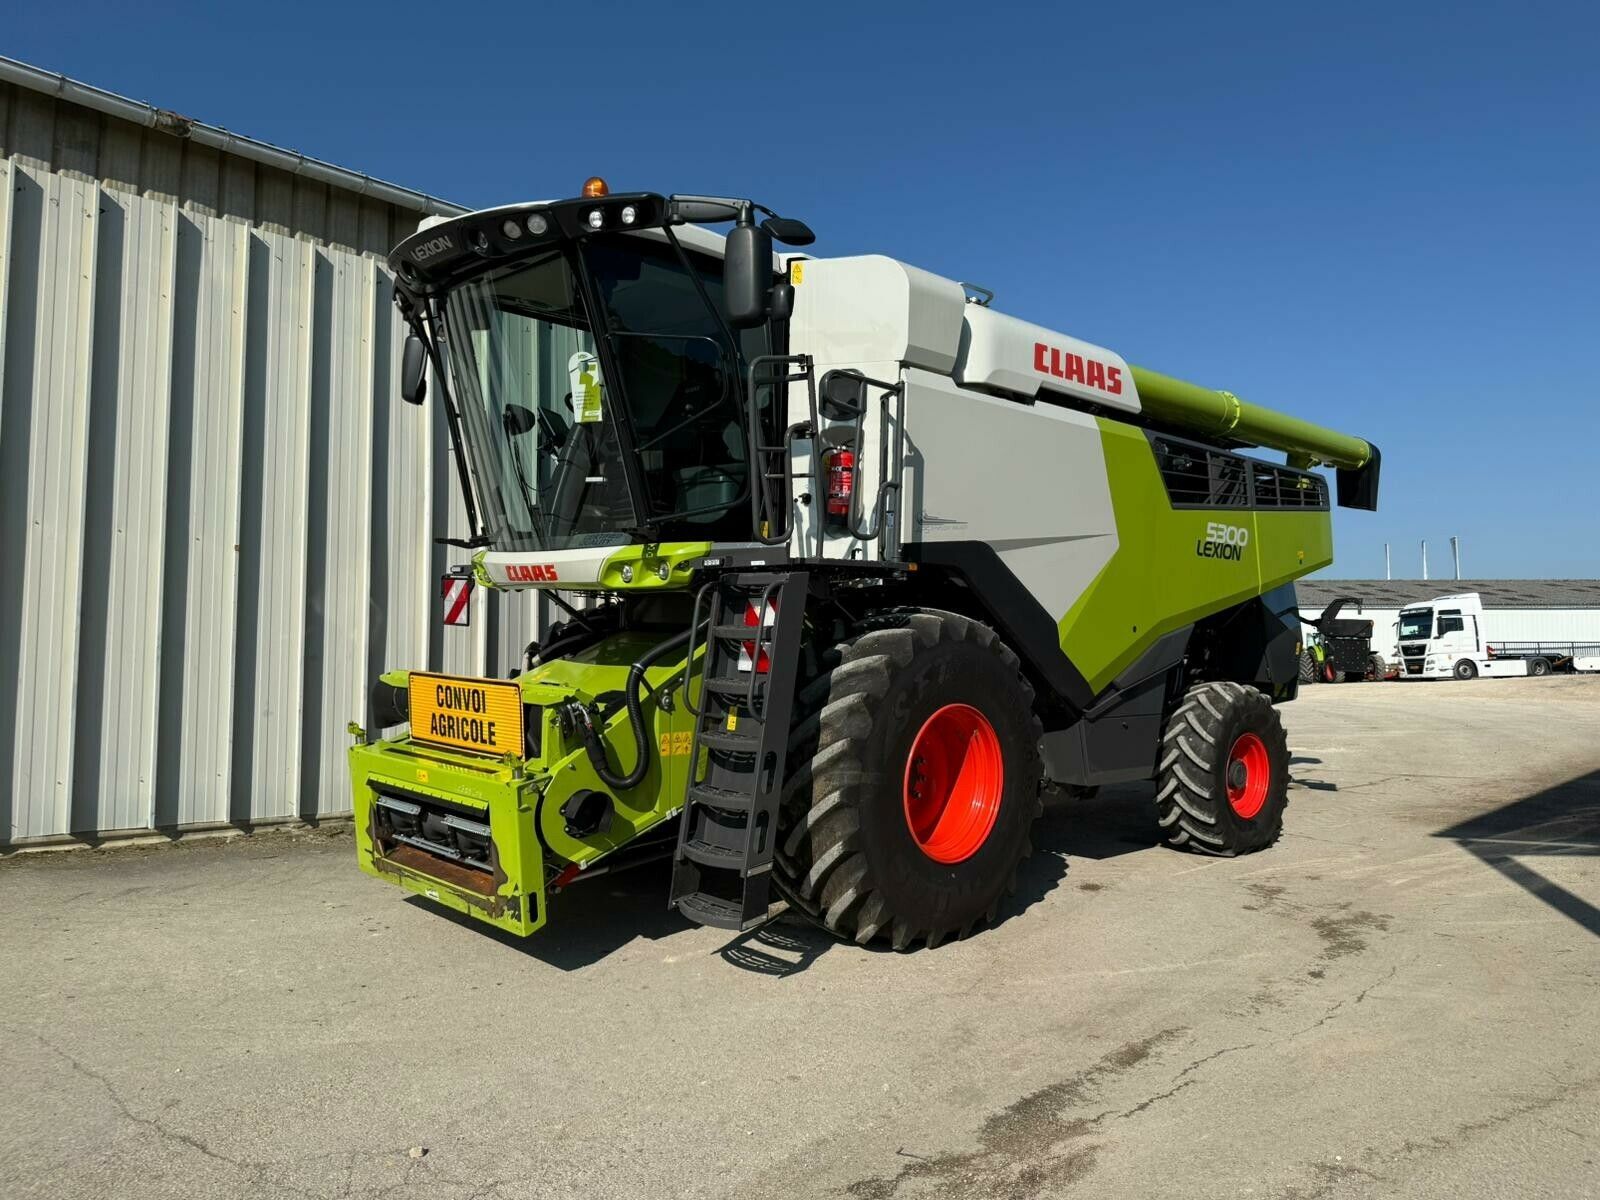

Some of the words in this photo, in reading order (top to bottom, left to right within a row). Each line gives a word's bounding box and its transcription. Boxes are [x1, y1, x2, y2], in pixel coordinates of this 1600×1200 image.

[410, 235, 453, 261] LEXION
[1034, 342, 1121, 395] CLAAS
[1206, 521, 1248, 547] 5300
[1196, 540, 1242, 561] LEXION
[505, 564, 558, 582] CLAAS
[436, 684, 486, 714] CONVOI
[430, 712, 497, 746] AGRICOLE
